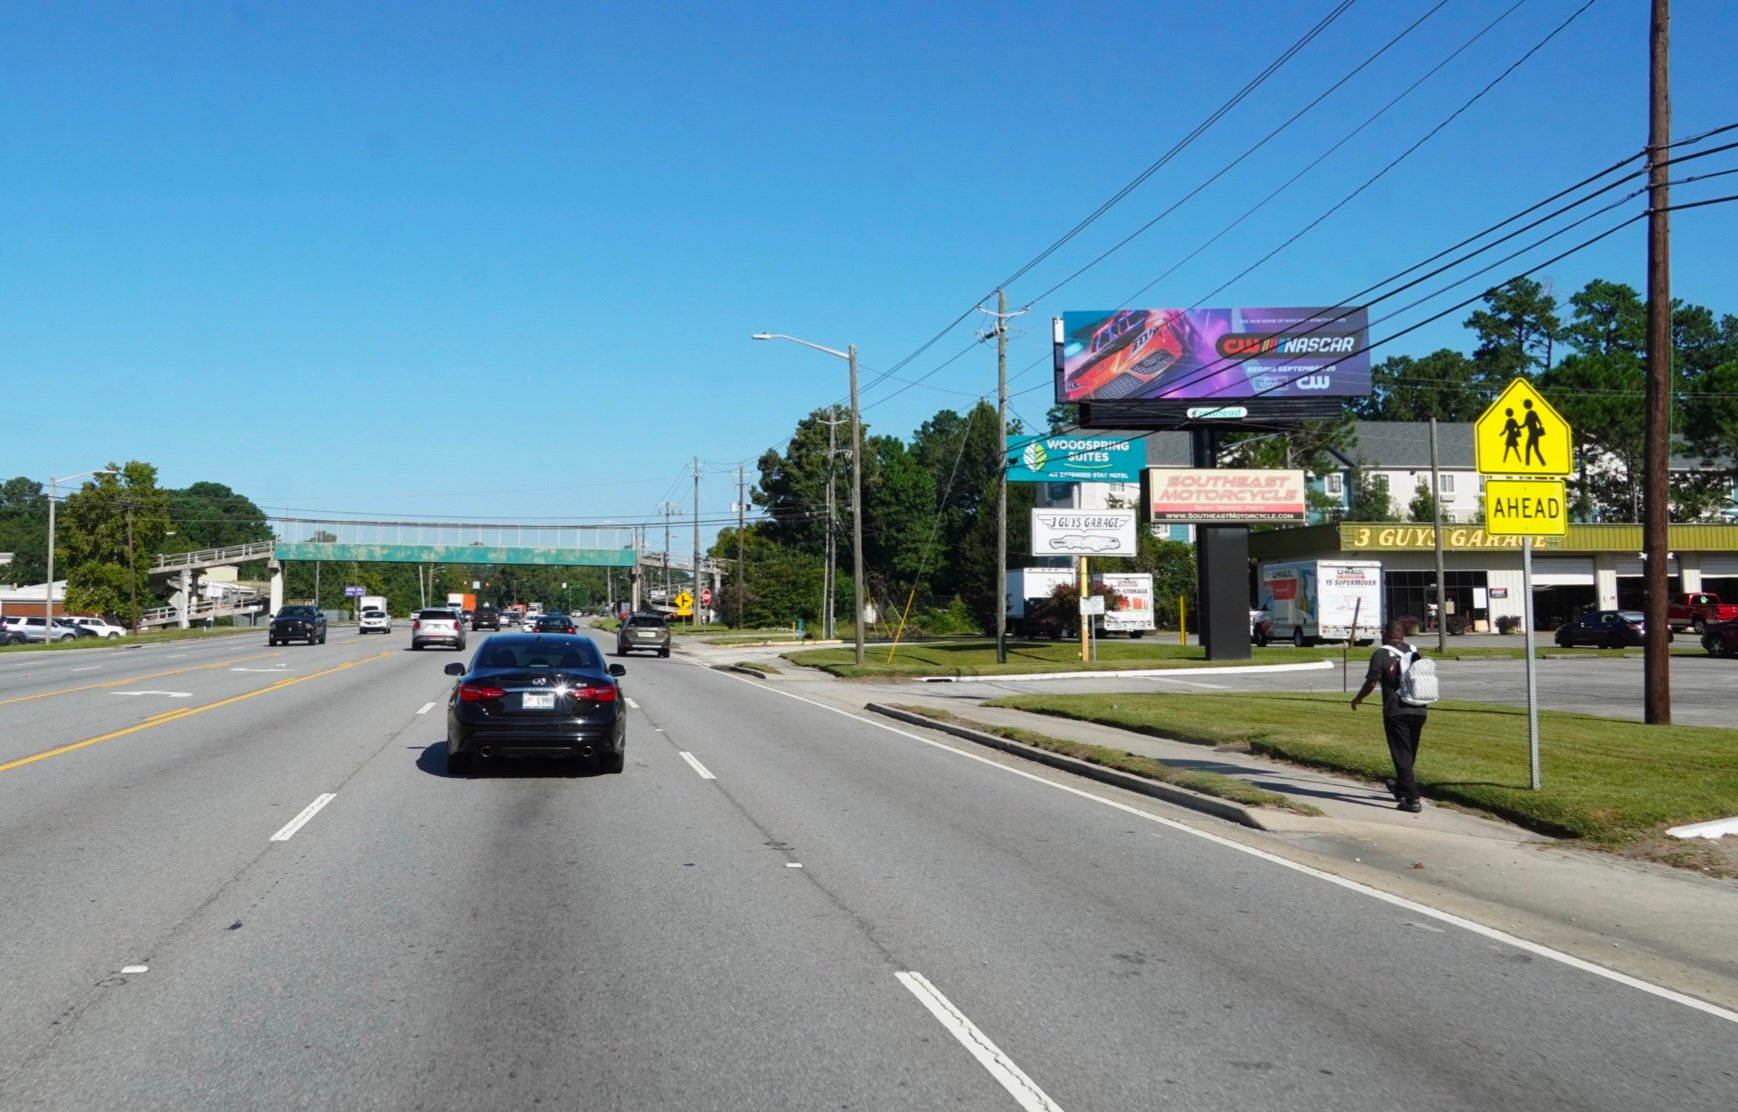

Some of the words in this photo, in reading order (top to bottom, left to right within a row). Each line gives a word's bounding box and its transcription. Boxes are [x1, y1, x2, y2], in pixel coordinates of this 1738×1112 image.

[1283, 336, 1355, 353] NASCAR
[1047, 440, 1130, 451] WOODSPRING
[1068, 452, 1109, 462] SUITES
[1167, 475, 1289, 488] SOUTHEAST
[1160, 490, 1297, 501] MOTORCYCLE
[1493, 497, 1560, 519] AHEAD
[1051, 517, 1057, 527] 3
[1058, 517, 1081, 528] GUYS
[1084, 517, 1119, 528] GARAGE
[1354, 528, 1370, 546] 3
